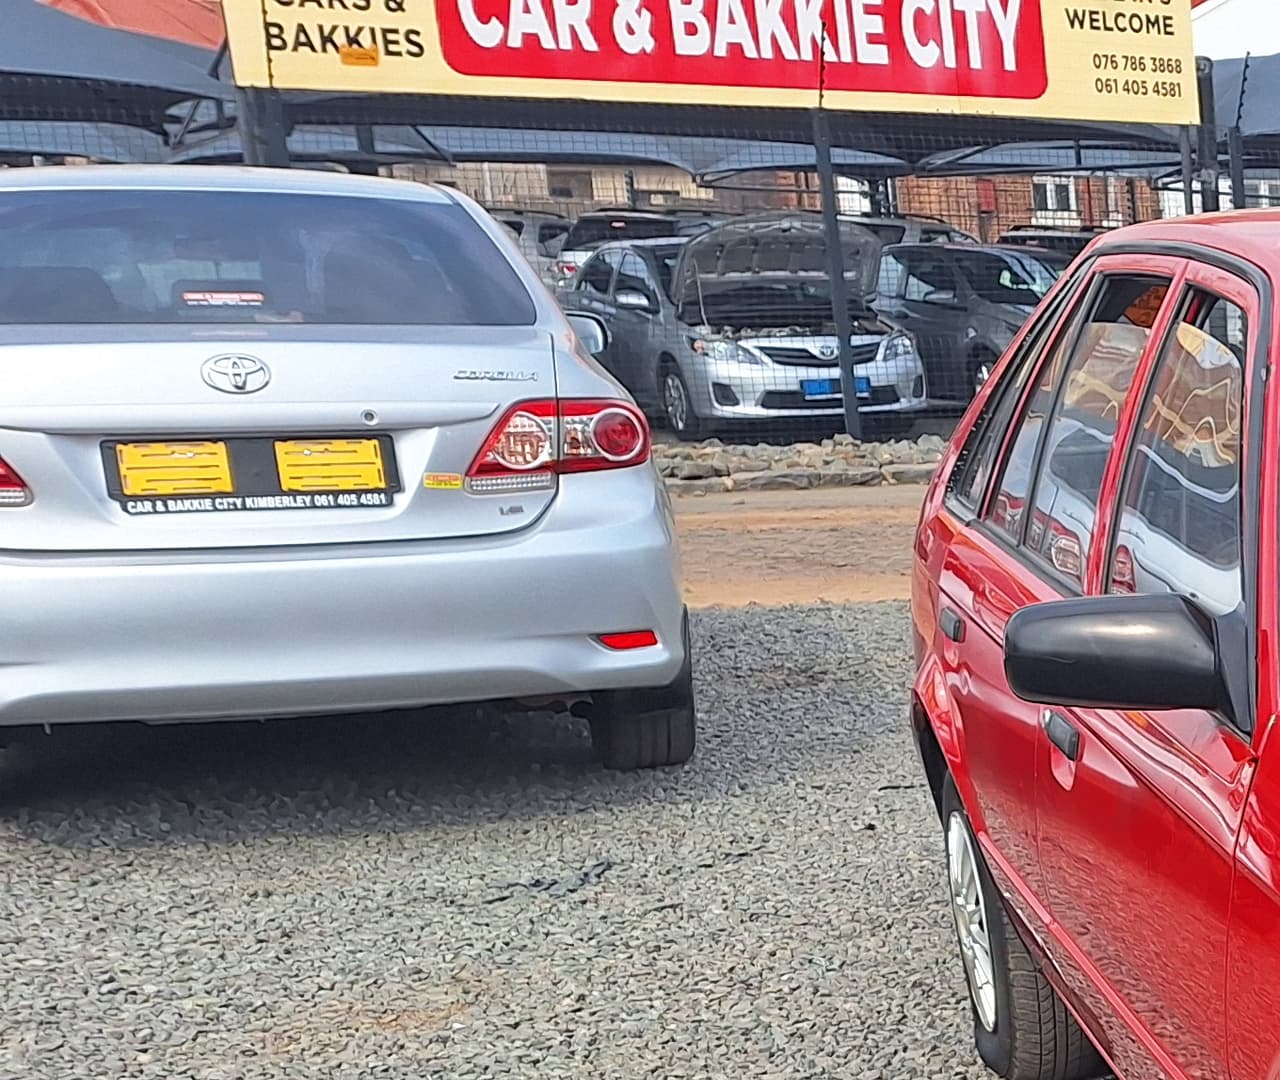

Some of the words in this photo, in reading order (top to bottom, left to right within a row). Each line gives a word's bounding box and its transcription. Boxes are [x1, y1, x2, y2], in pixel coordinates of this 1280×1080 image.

[1065, 8, 1175, 36] WELCOME
[265, 22, 425, 58] BAKKIES
[456, 0, 600, 51] CAR
[612, 0, 656, 54] &
[667, 0, 890, 64] BAKKIE
[900, 0, 1021, 71] CITY
[1093, 53, 1119, 70] 076
[1122, 55, 1146, 72] 786
[1150, 57, 1182, 74] 3868
[1095, 78, 1119, 94] 061
[1122, 80, 1148, 96] 405
[1152, 81, 1182, 98] 4581
[127, 501, 153, 514] CAR
[156, 501, 166, 512] &
[168, 499, 214, 512] BAKKIE
[215, 498, 243, 510] CITY
[245, 495, 311, 509] KIMBERLEY
[314, 494, 335, 506] 061
[337, 494, 358, 505] 405
[360, 493, 387, 505] 4581
